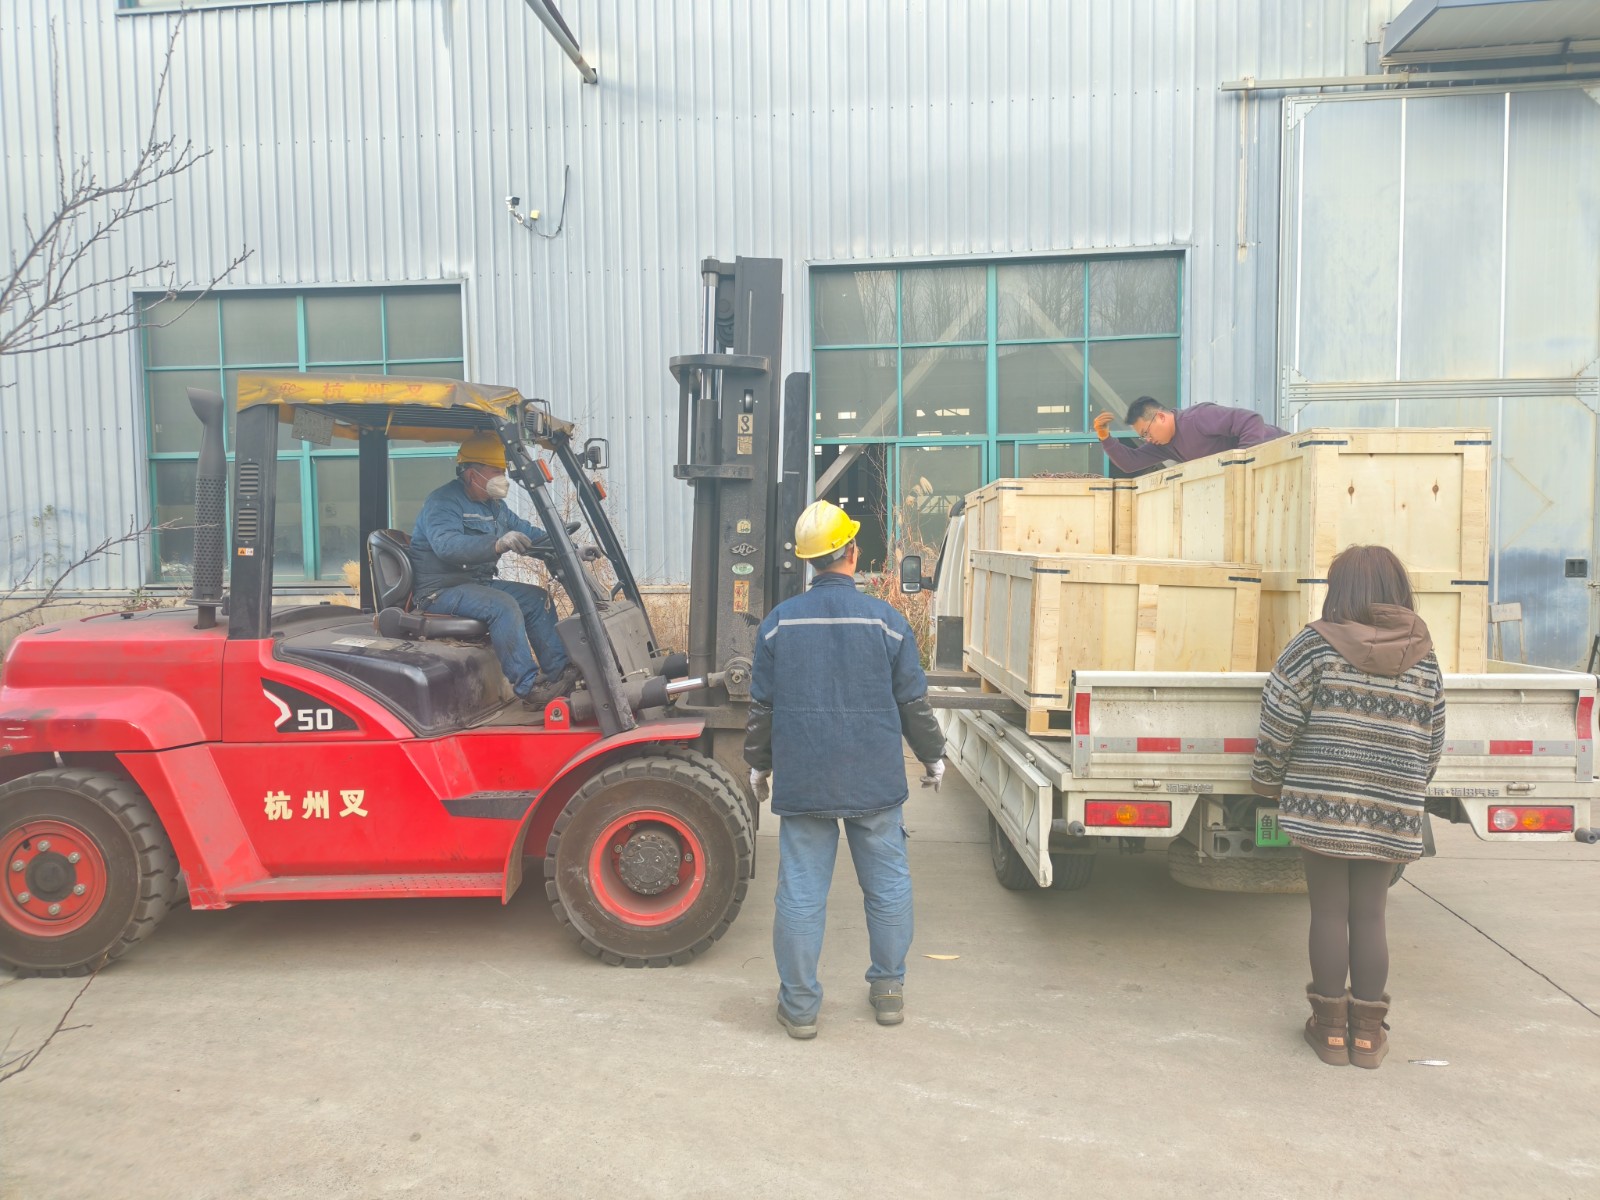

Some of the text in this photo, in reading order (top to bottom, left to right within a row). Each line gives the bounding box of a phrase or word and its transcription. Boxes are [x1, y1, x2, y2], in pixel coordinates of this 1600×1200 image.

[322, 381, 456, 400] 杭州叉
[297, 708, 334, 731] 50
[264, 789, 369, 821] 杭州叉
[1260, 814, 1279, 841] 鲁
